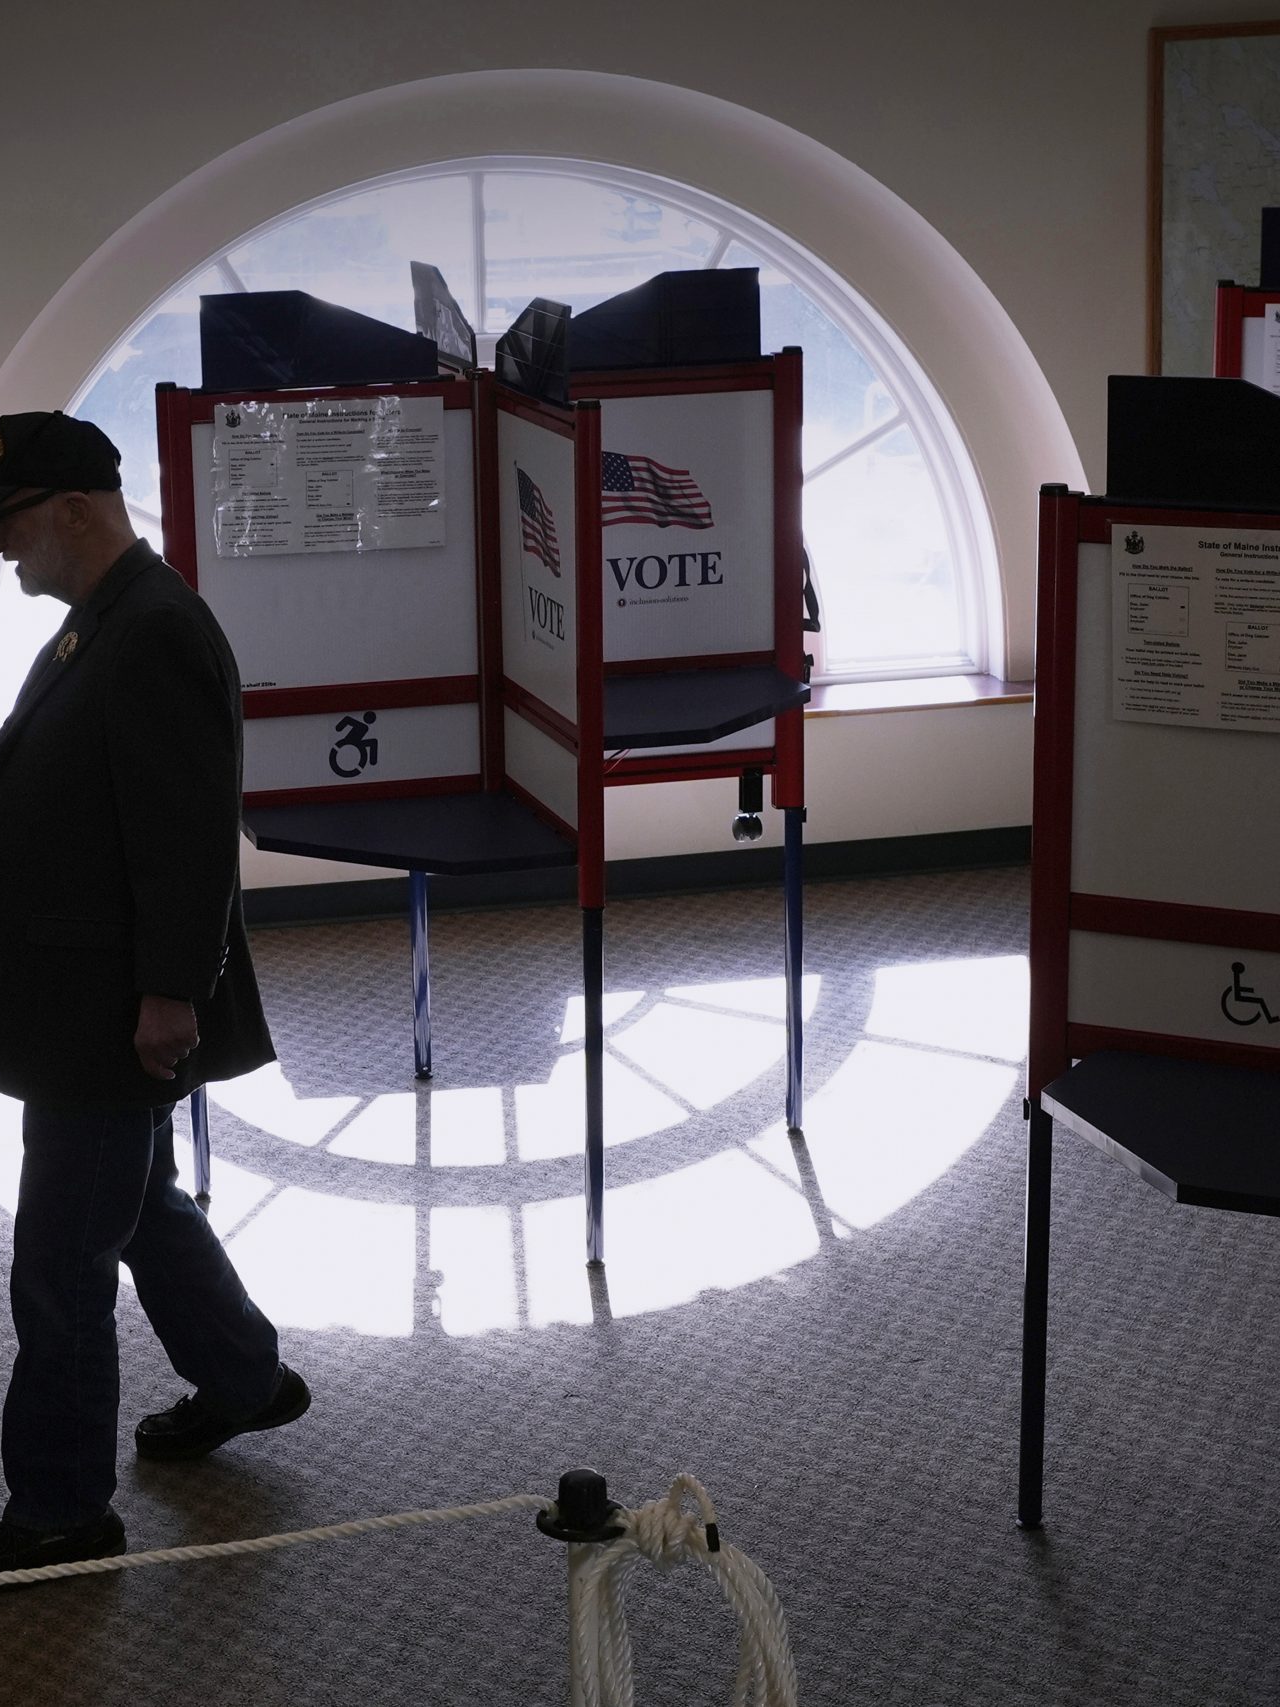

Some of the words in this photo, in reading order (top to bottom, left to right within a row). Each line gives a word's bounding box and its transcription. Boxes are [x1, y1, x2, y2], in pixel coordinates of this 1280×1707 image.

[1198, 540, 1221, 550] State
[1223, 542, 1232, 550] of
[1234, 542, 1260, 551] Maine
[606, 551, 724, 592] VOTE
[528, 586, 565, 641] VOTE
